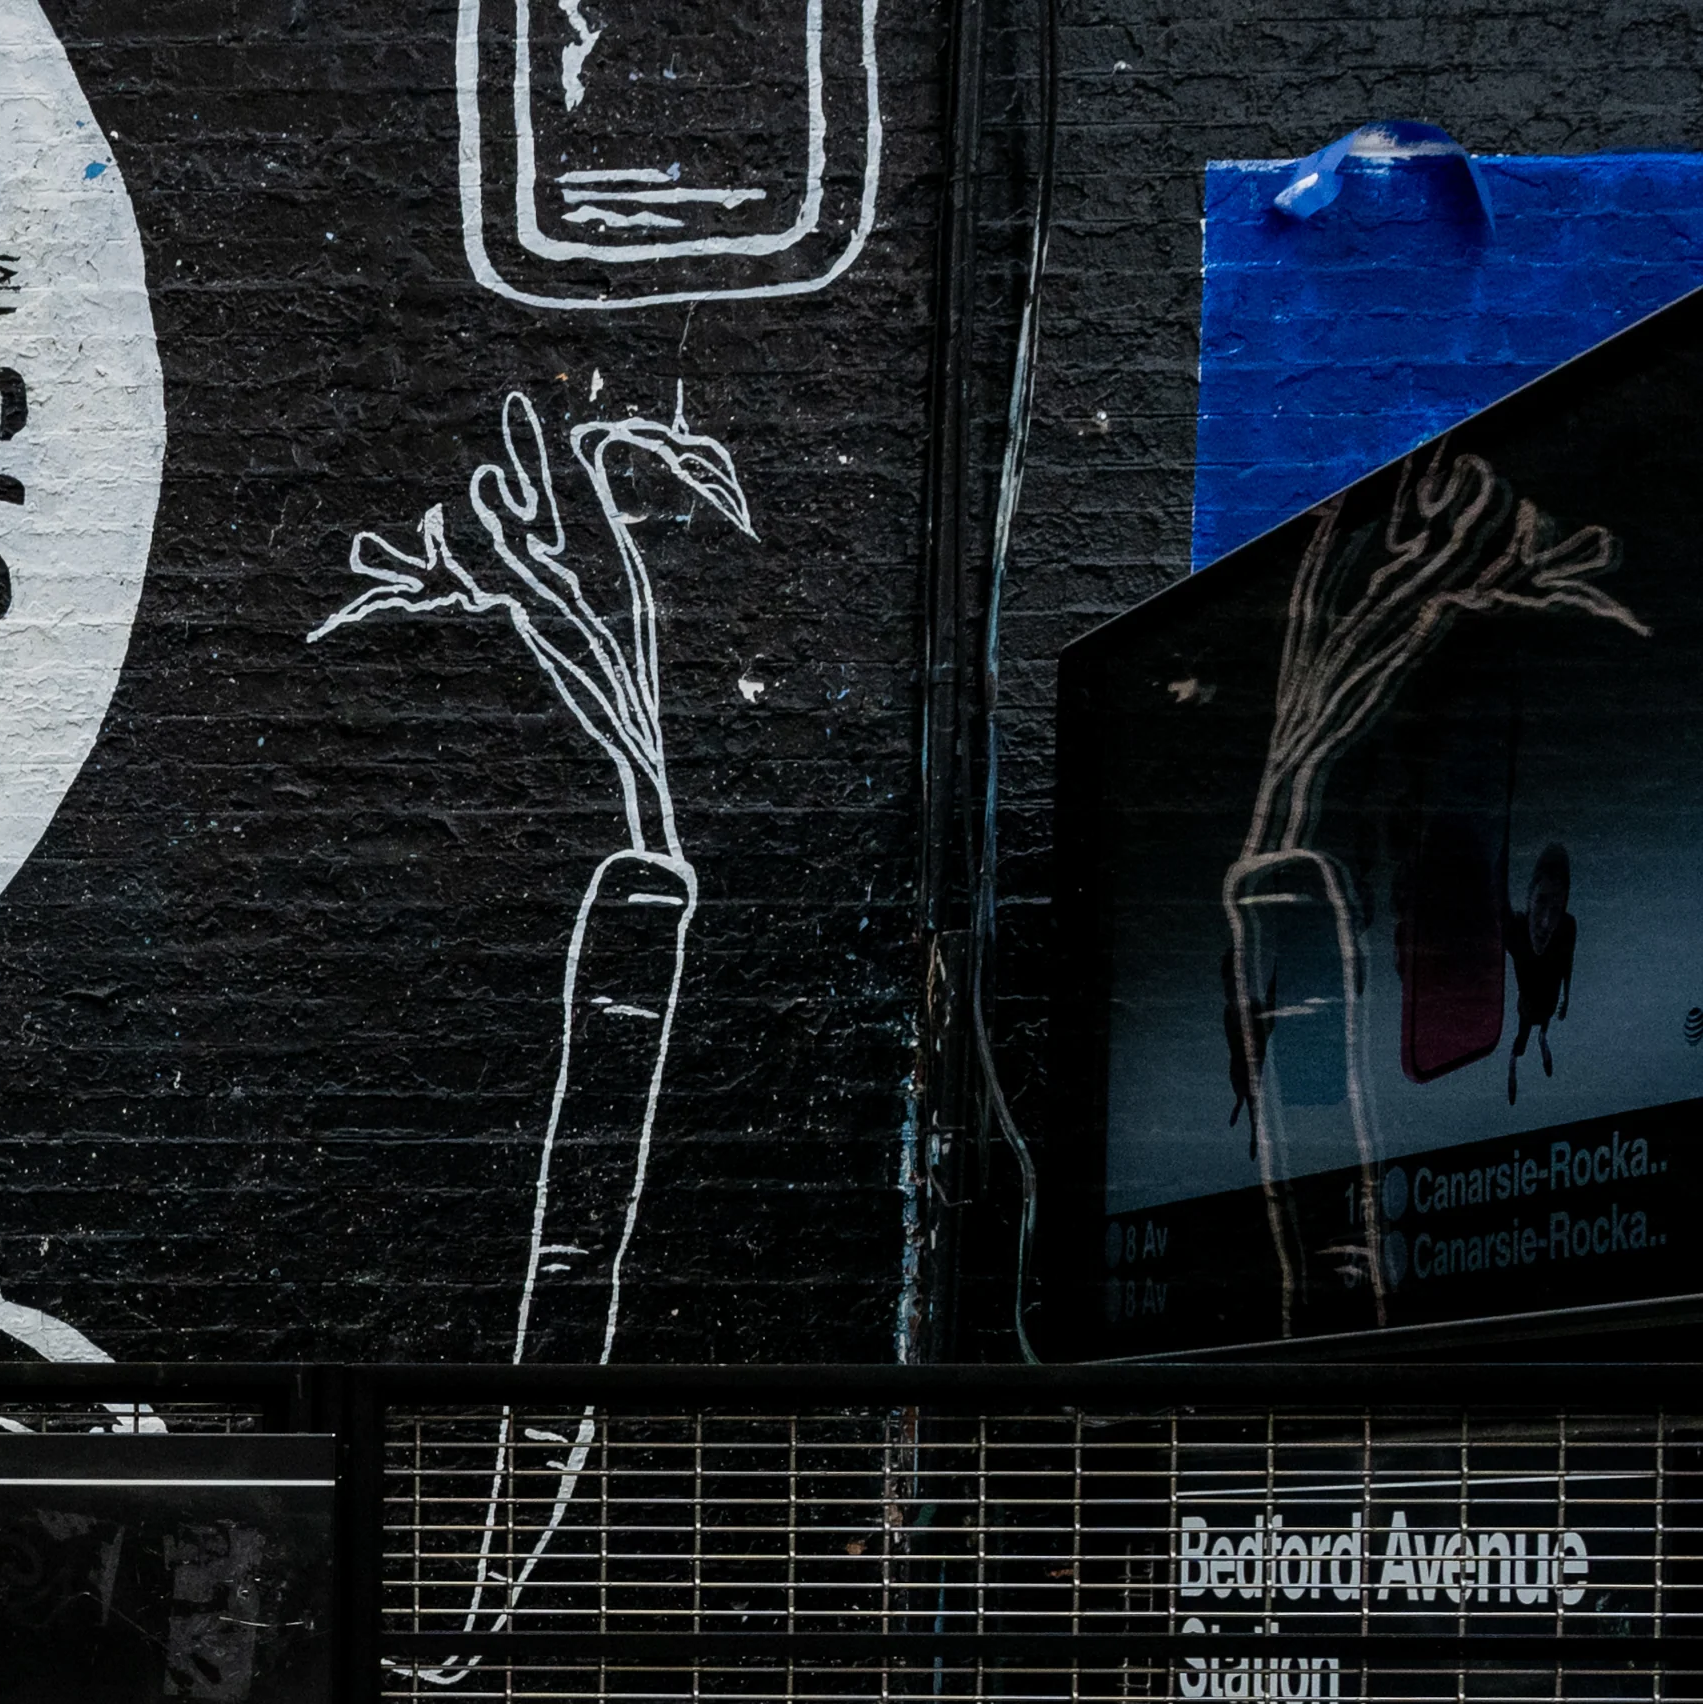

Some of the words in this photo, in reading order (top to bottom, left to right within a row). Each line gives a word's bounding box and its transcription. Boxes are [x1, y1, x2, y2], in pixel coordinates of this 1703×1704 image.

[1124, 1223, 1137, 1264] 8
[1142, 1219, 1169, 1260] Av
[1142, 1275, 1169, 1316] Av
[1179, 1512, 1363, 1601] Bedford
[1378, 1511, 1590, 1605] Avenue
